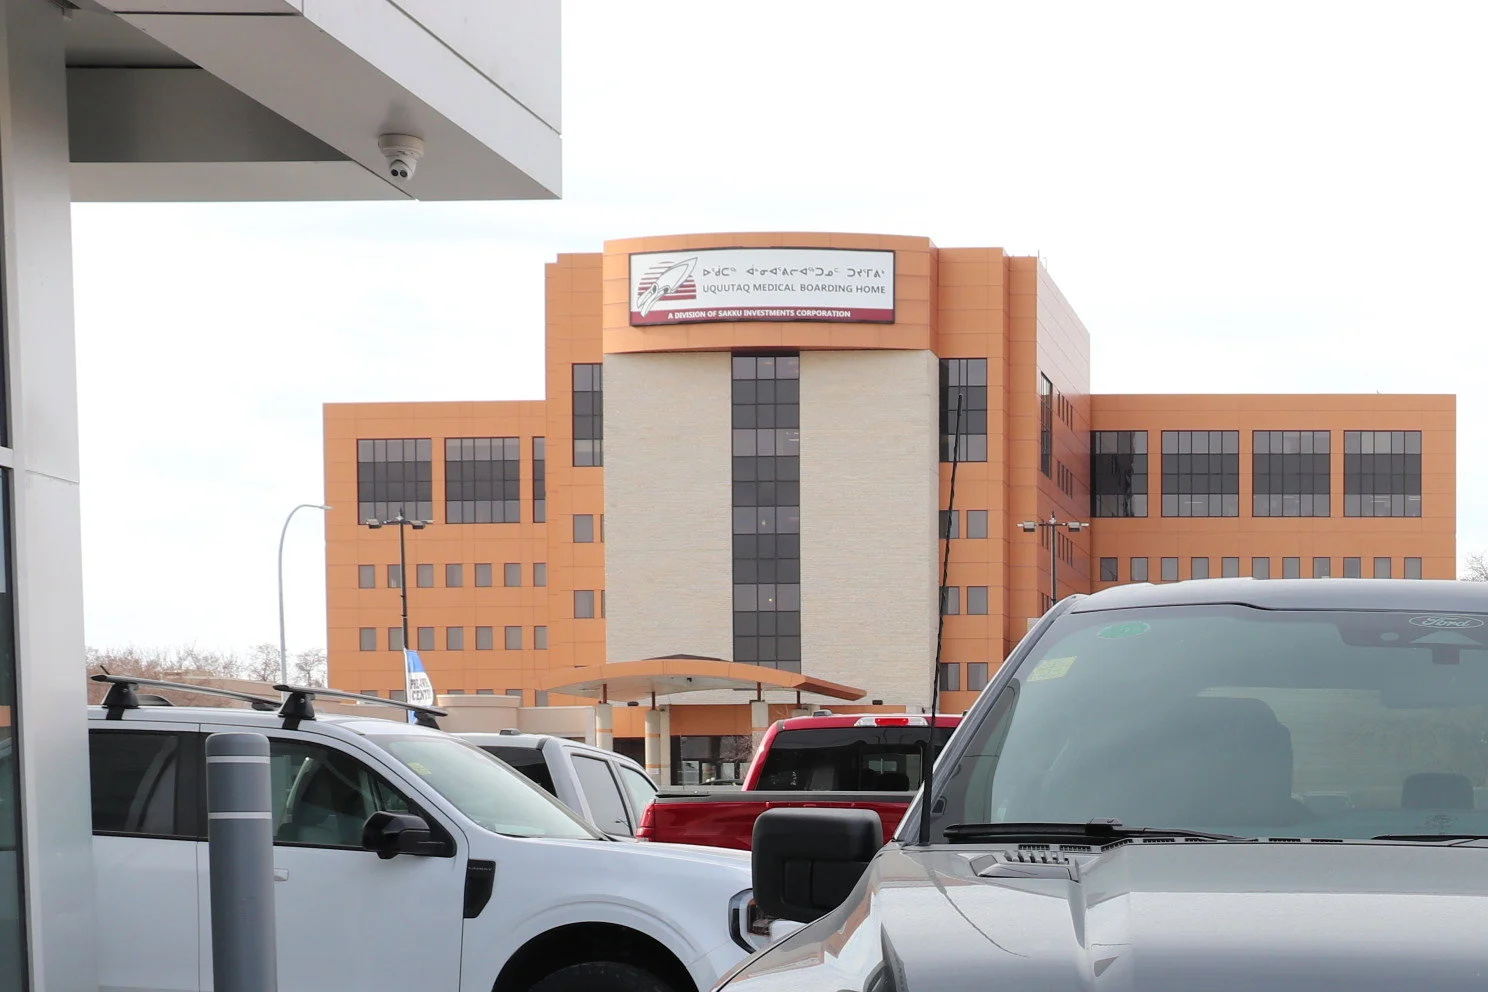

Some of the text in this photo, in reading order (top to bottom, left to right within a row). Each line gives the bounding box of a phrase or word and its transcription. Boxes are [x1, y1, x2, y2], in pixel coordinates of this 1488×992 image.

[702, 283, 886, 294] UQUUTAQ MEDICAL BOARDING HOME
[674, 311, 706, 319] DIVISION
[743, 309, 795, 317] INVESTMENTS
[796, 310, 851, 318] CORPORATION
